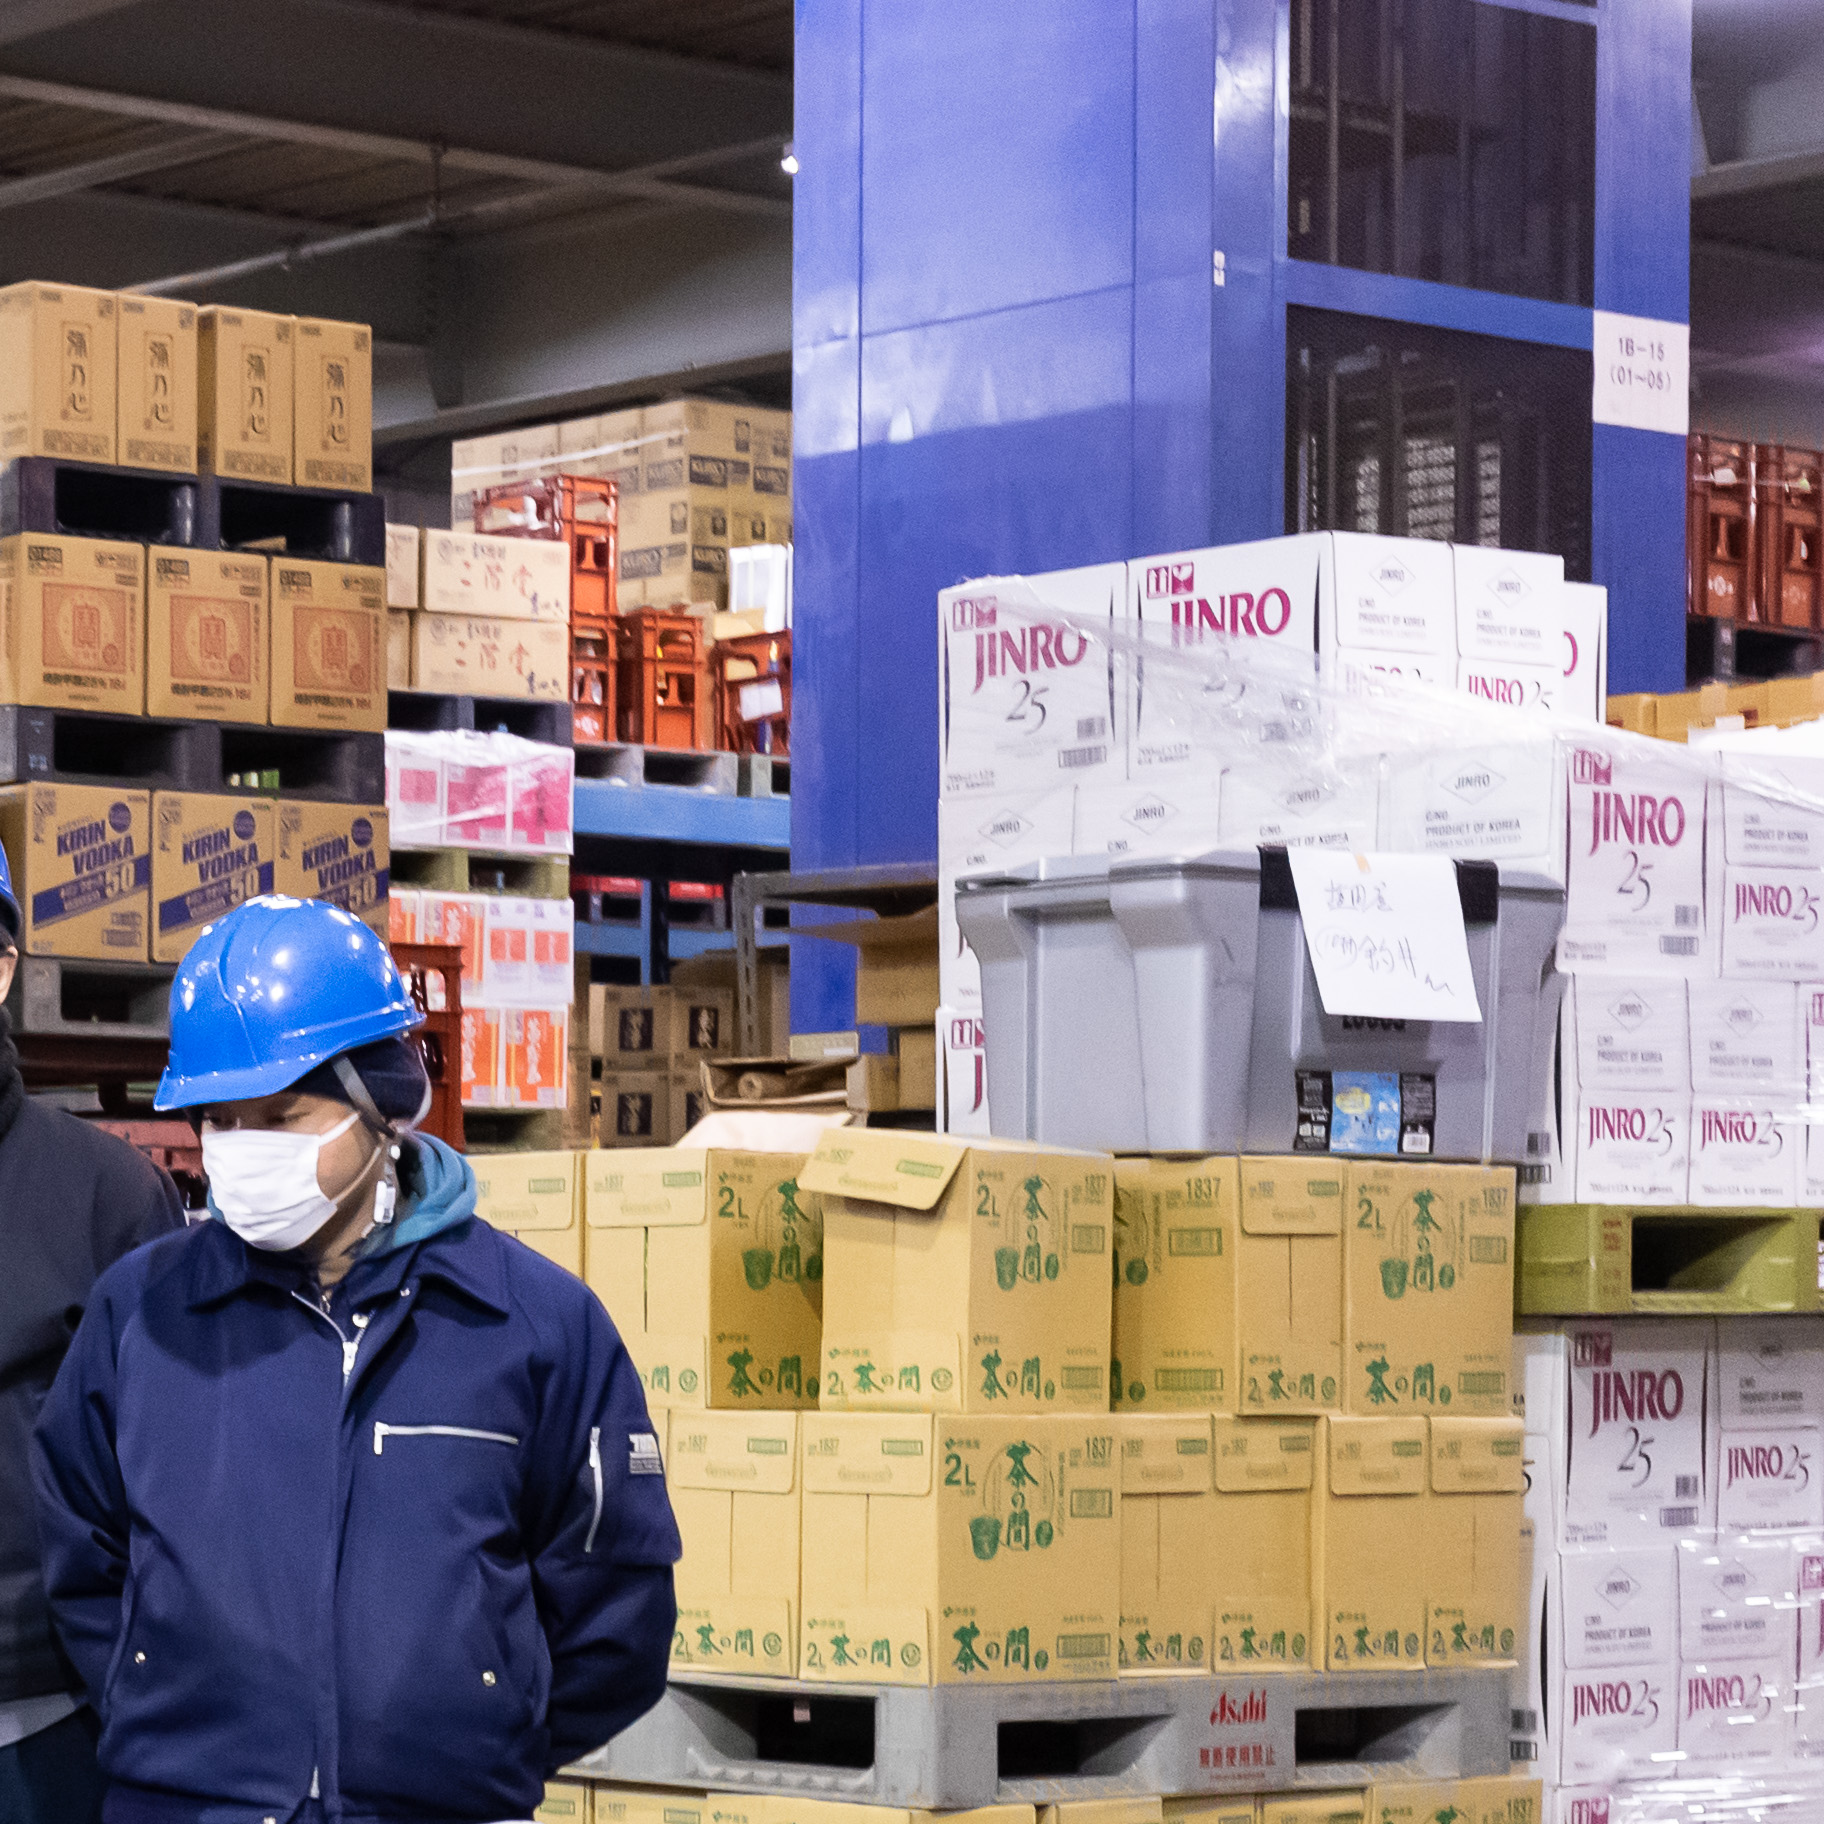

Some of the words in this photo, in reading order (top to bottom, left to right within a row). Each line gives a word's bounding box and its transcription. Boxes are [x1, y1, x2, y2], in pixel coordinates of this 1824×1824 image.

[1171, 587, 1291, 649] JINRO
[973, 624, 1088, 694] JINRO
[1006, 680, 1049, 736] 25
[1454, 774, 1491, 790] JINRO
[57, 819, 106, 857] KIRIN
[1589, 792, 1685, 857] JINRO
[72, 835, 135, 876] VODKA
[182, 828, 230, 864] KIRIN
[198, 843, 259, 883] VODKA
[301, 835, 349, 872] KIRIN
[317, 850, 376, 889] VODKA
[1617, 851, 1654, 912] 25
[1735, 884, 1792, 924] JINRO
[1793, 886, 1820, 934] 25
[1589, 1107, 1646, 1149] JINRO
[1647, 1108, 1675, 1157] 25
[1701, 1110, 1757, 1151] JINRO
[719, 1186, 750, 1220] 2L
[977, 1184, 1000, 1217] 2L
[1186, 1178, 1221, 1199] 1837
[1024, 1175, 1048, 1283] 茶の間
[1358, 1198, 1385, 1230] 2L
[1413, 1188, 1442, 1292] 茶の間
[727, 1348, 801, 1398] 茶の間
[854, 1361, 920, 1393] 茶の間
[981, 1349, 1041, 1400] 茶の間
[1268, 1369, 1315, 1401] 茶の間
[1366, 1356, 1434, 1405] 茶の間
[1589, 1369, 1684, 1439] JINRO
[944, 1453, 976, 1486] 2L
[1085, 1437, 1113, 1461] 1837
[1618, 1426, 1655, 1488] 25
[1727, 1446, 1783, 1490] JINRO
[1783, 1444, 1811, 1492] 25
[1006, 1440, 1038, 1552] 茶の間
[696, 1623, 753, 1657] 茶の間
[830, 1634, 891, 1669] 茶の間
[953, 1621, 1029, 1673] 茶の間
[1240, 1626, 1286, 1659] 茶の間
[1354, 1626, 1398, 1658] 茶の間
[1452, 1620, 1495, 1652] 茶の間
[1210, 1689, 1267, 1726] Asahi
[1573, 1681, 1631, 1726] JINRO
[1631, 1680, 1661, 1729] 25
[1687, 1674, 1744, 1720] JINRO
